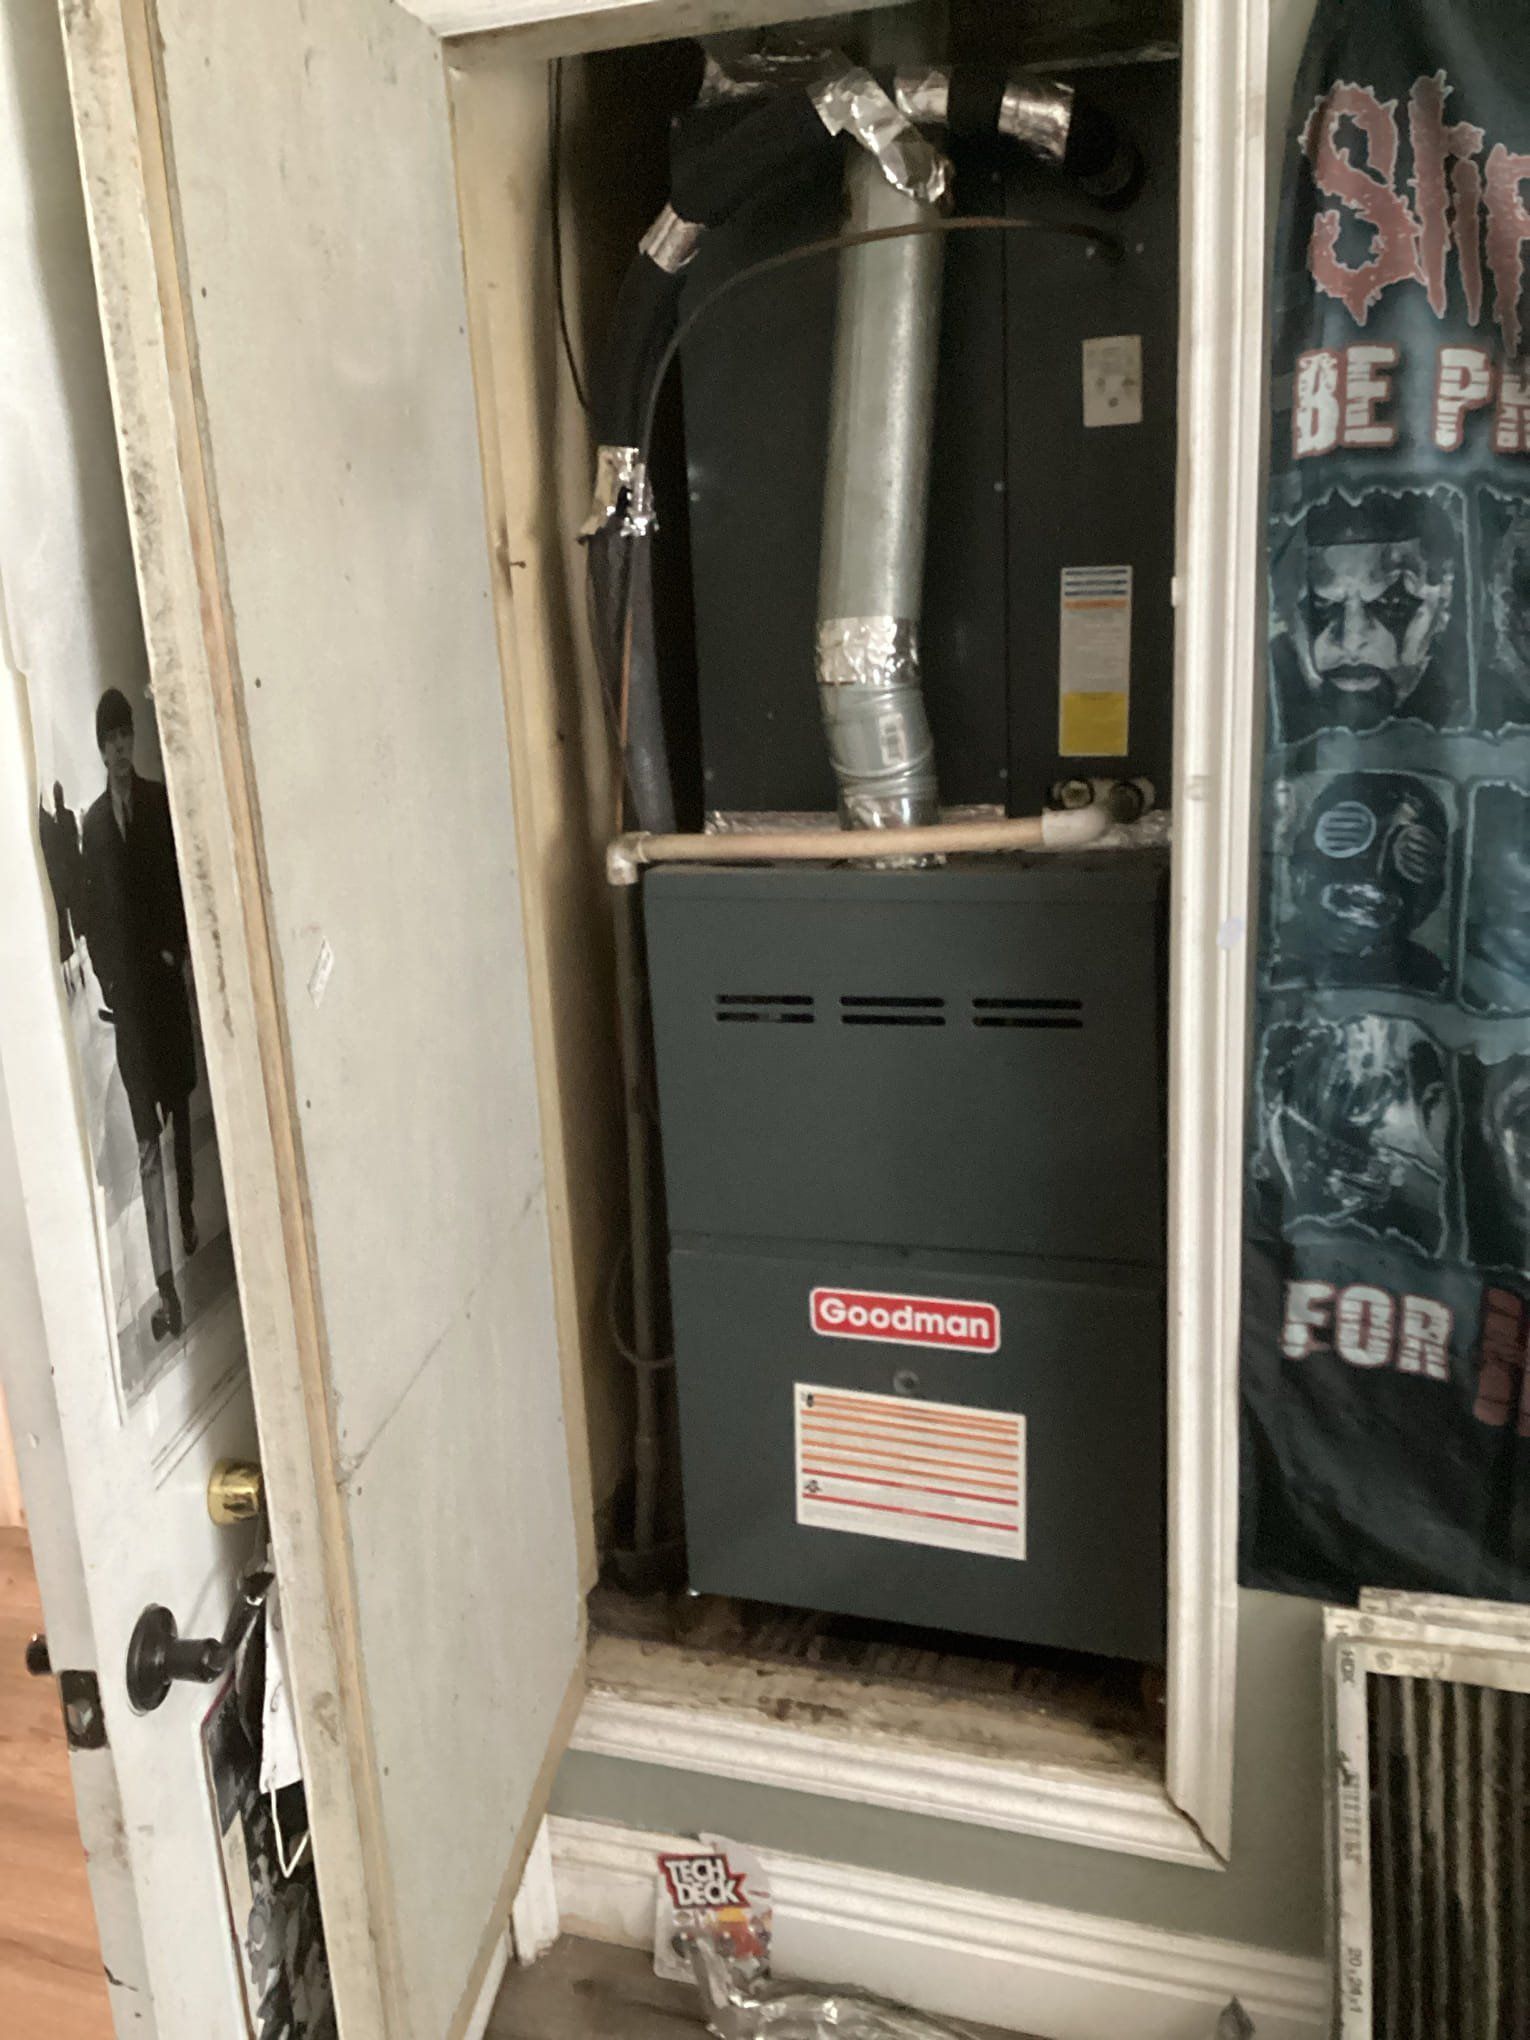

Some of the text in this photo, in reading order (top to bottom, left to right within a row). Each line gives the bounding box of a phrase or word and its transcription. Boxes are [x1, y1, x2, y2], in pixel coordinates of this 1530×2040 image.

[1293, 342, 1398, 459] BE
[820, 1297, 989, 1340] Goodman
[1280, 1279, 1453, 1381] FOR
[666, 1859, 726, 1882] TECH
[677, 1880, 739, 1905] DECK
